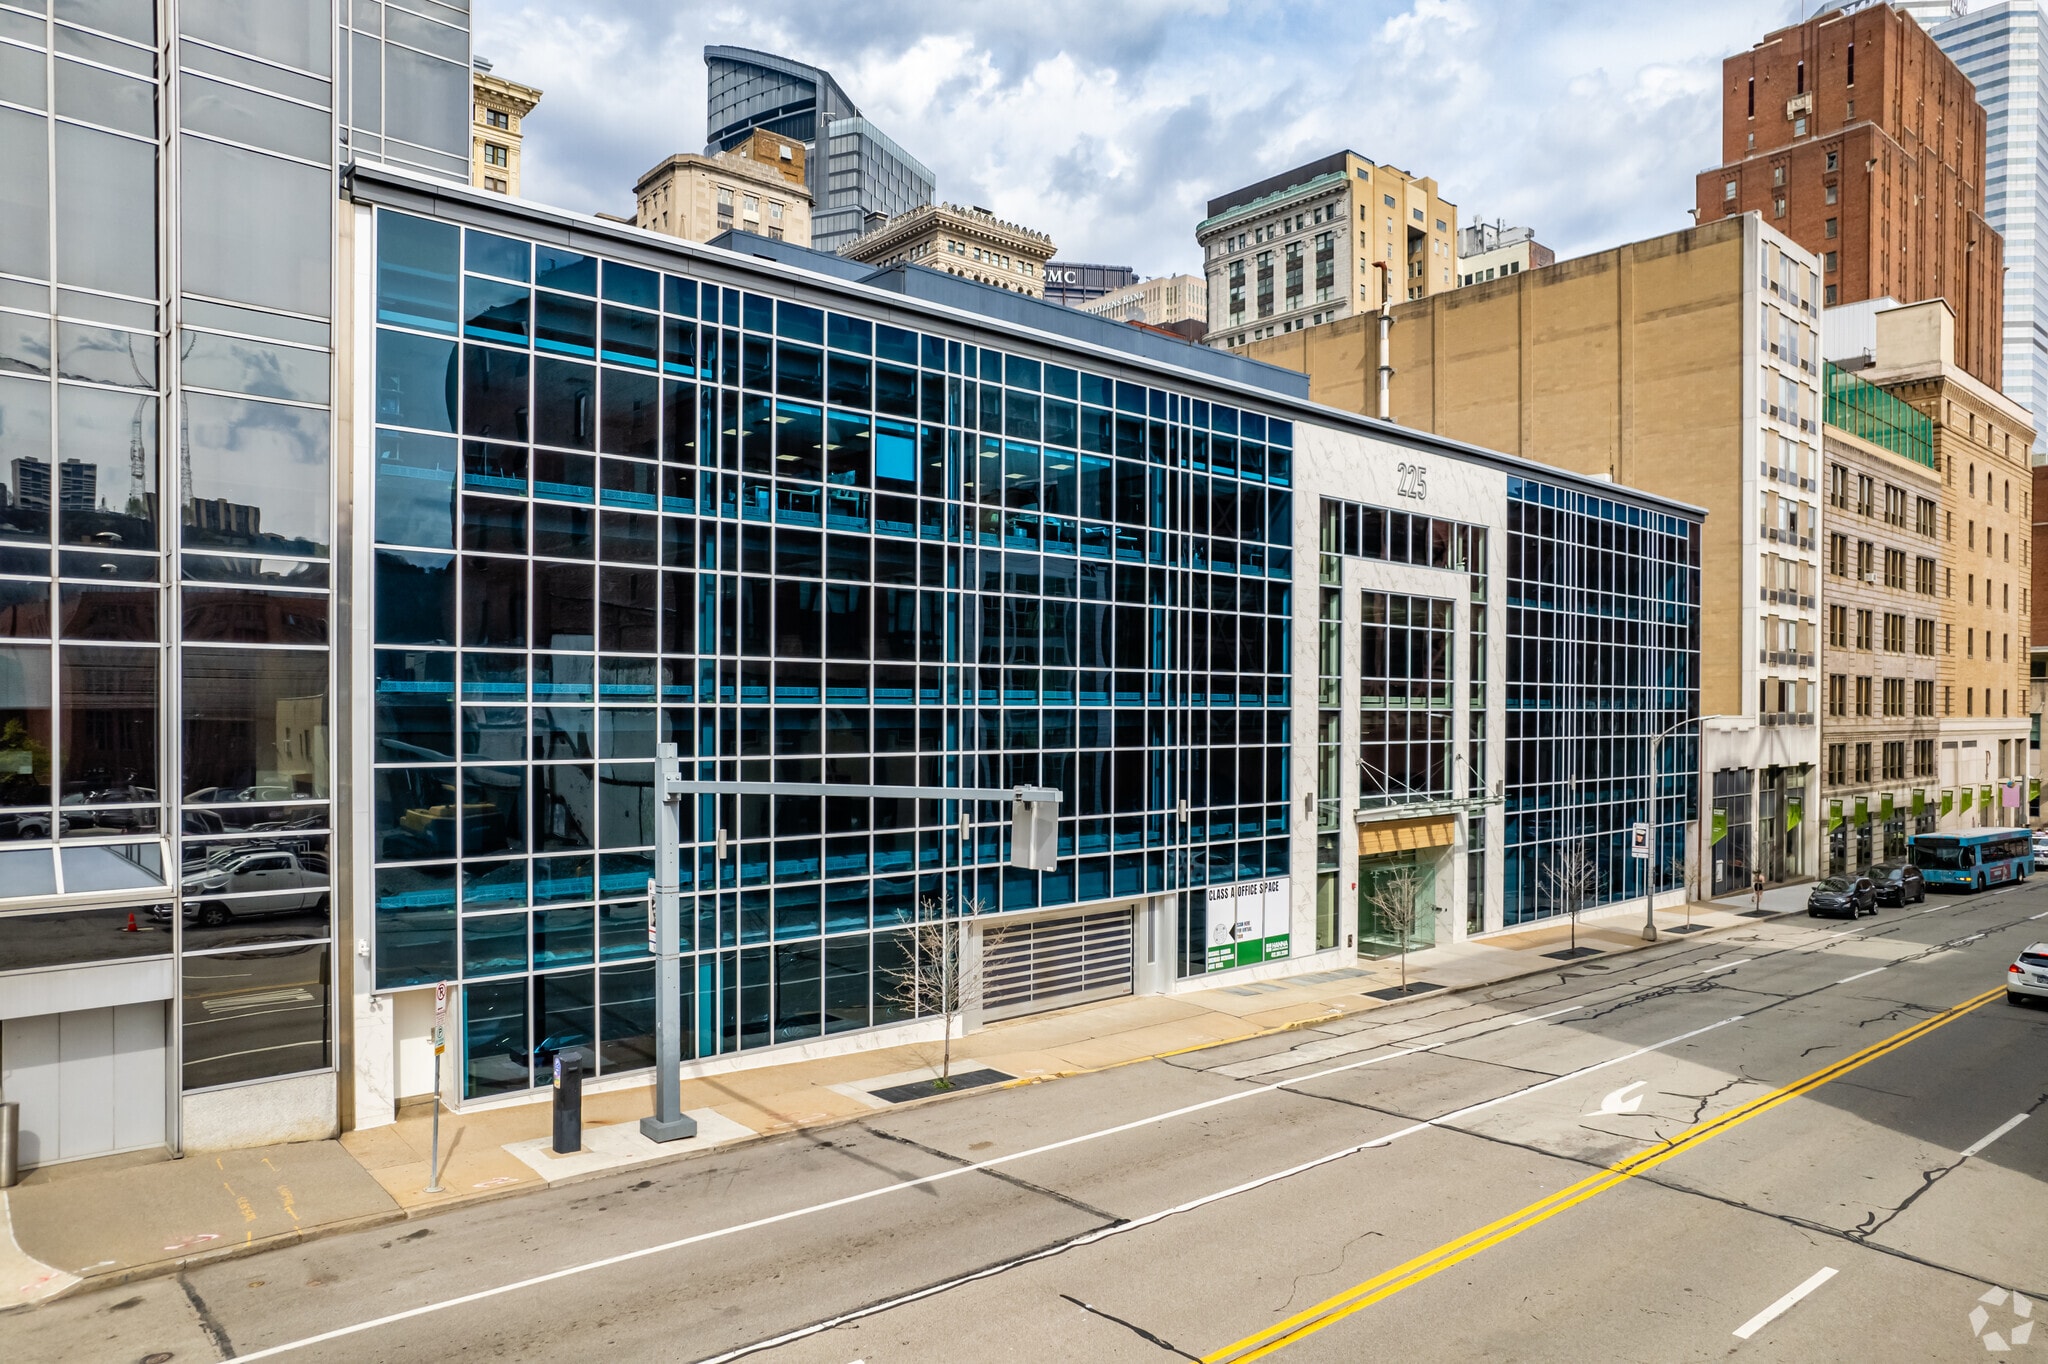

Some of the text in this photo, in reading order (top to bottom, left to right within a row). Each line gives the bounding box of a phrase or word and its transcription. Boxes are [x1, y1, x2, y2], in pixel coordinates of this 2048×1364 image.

[1124, 291, 1145, 305] BANK
[1397, 462, 1427, 500] 225
[1209, 881, 1279, 901] CLASS A OFFICE SPACE
